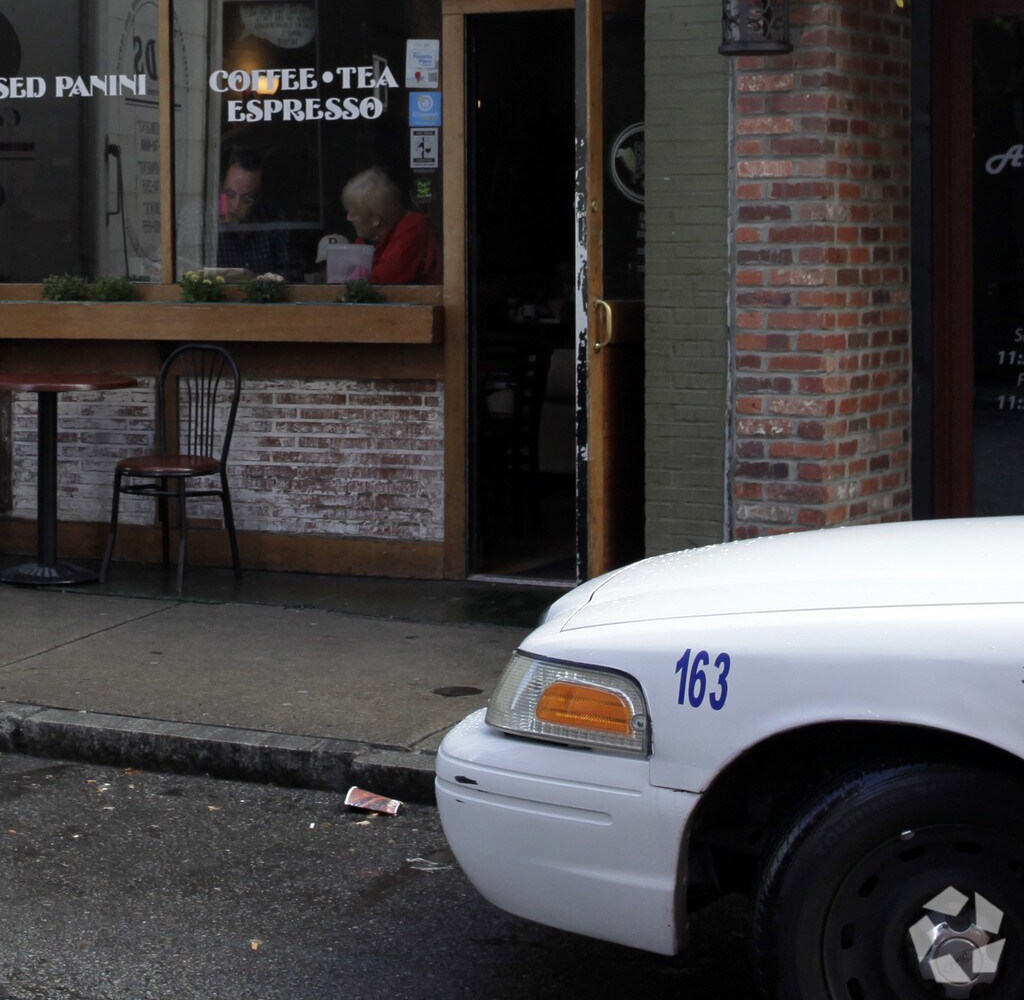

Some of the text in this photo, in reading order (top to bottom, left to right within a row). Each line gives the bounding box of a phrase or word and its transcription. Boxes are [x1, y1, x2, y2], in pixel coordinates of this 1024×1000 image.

[55, 74, 147, 97] PANINI
[226, 96, 384, 123] ESPRESSO
[675, 648, 731, 711] 163
